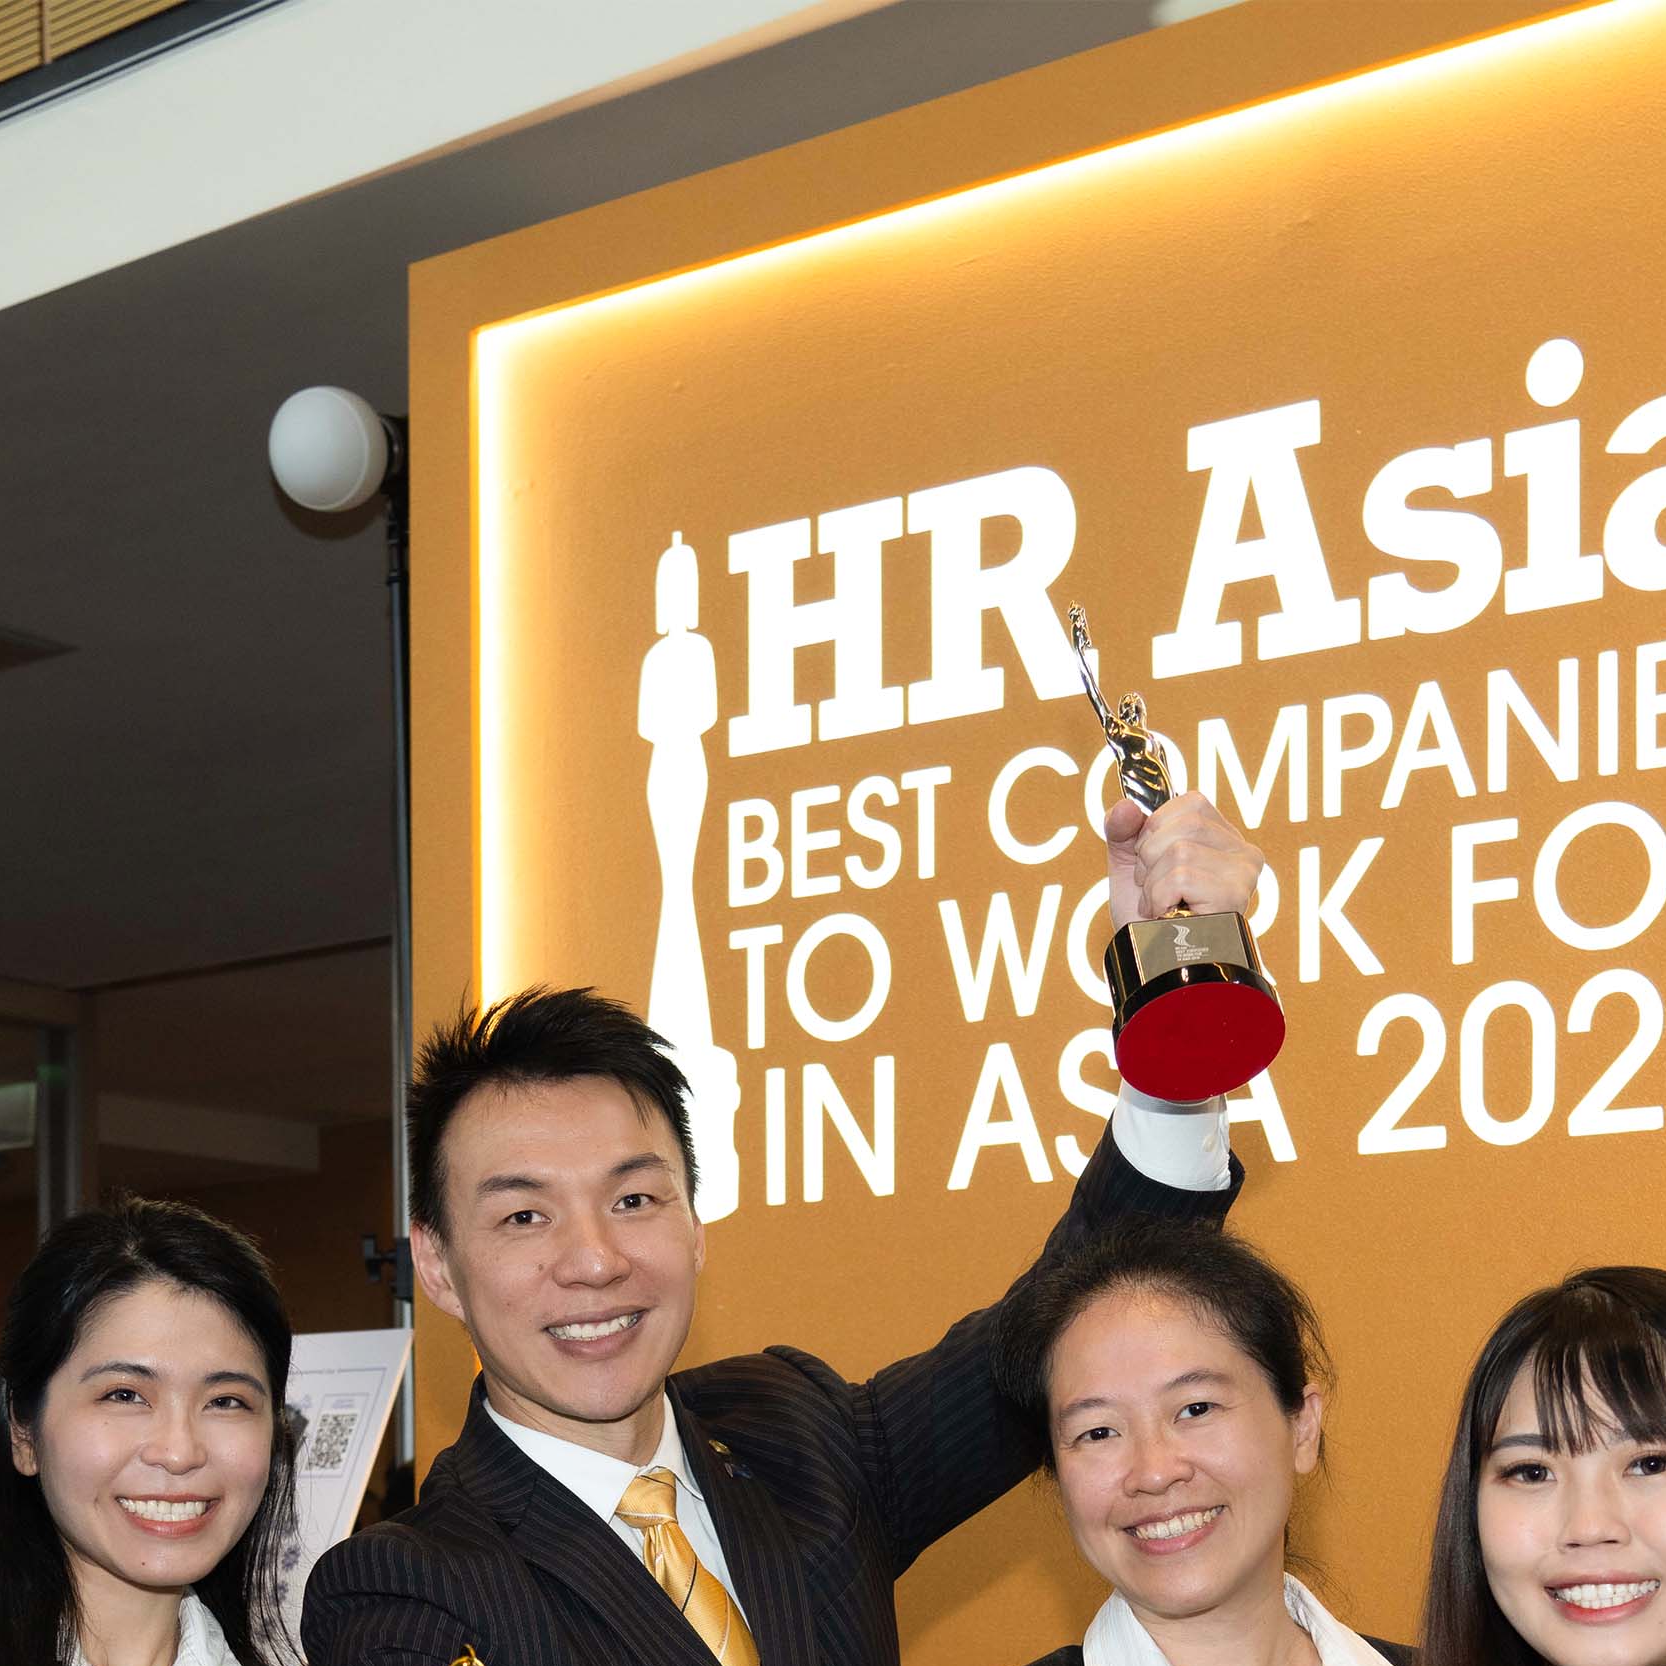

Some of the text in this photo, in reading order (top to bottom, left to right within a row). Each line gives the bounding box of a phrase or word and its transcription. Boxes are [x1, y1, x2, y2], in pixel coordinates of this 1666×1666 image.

[729, 466, 1099, 757] HR
[729, 775, 952, 908] BEST
[729, 914, 892, 1048] TO
[938, 837, 1385, 1023] WK
[766, 1056, 895, 1206] IN
